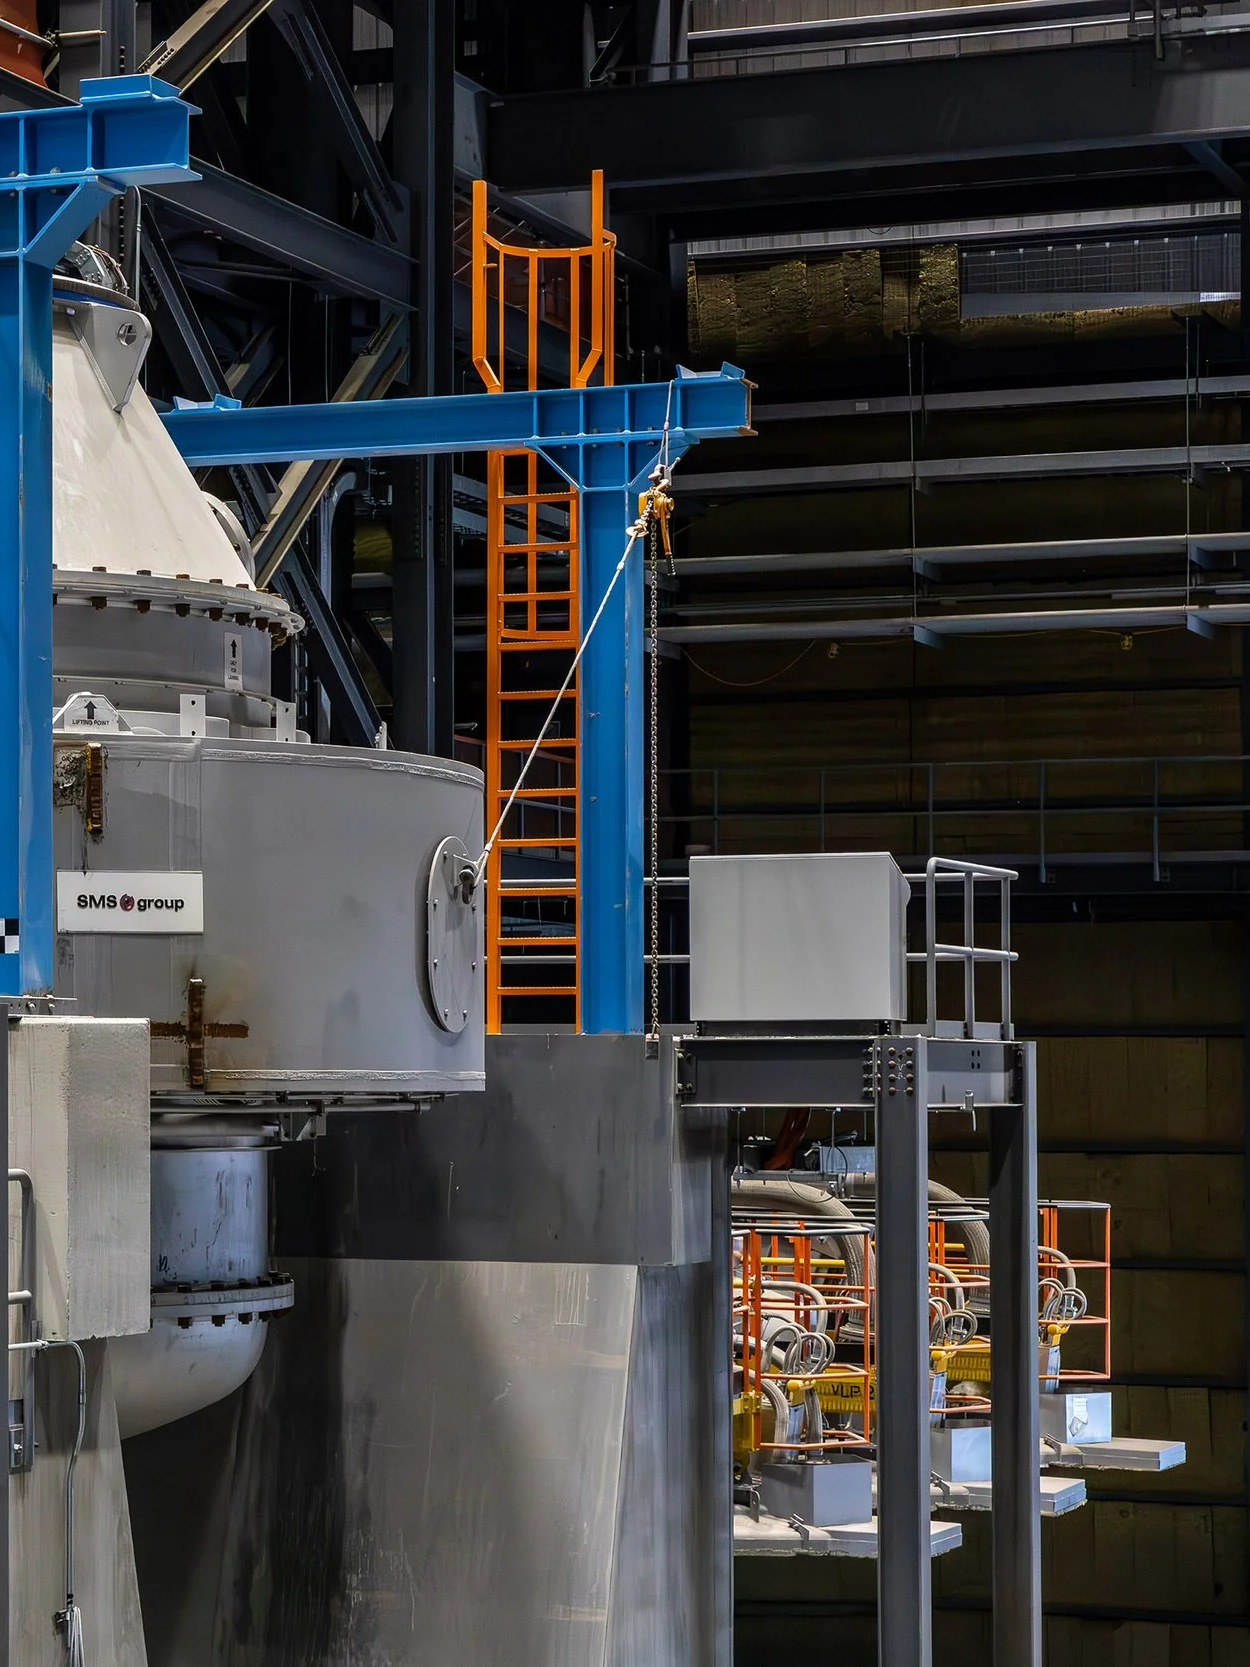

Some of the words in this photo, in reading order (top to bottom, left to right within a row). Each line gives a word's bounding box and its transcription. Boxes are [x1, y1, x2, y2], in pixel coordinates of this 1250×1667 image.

[77, 894, 118, 909] SMS
[137, 898, 185, 912] group
[831, 1383, 861, 1399] VLP
